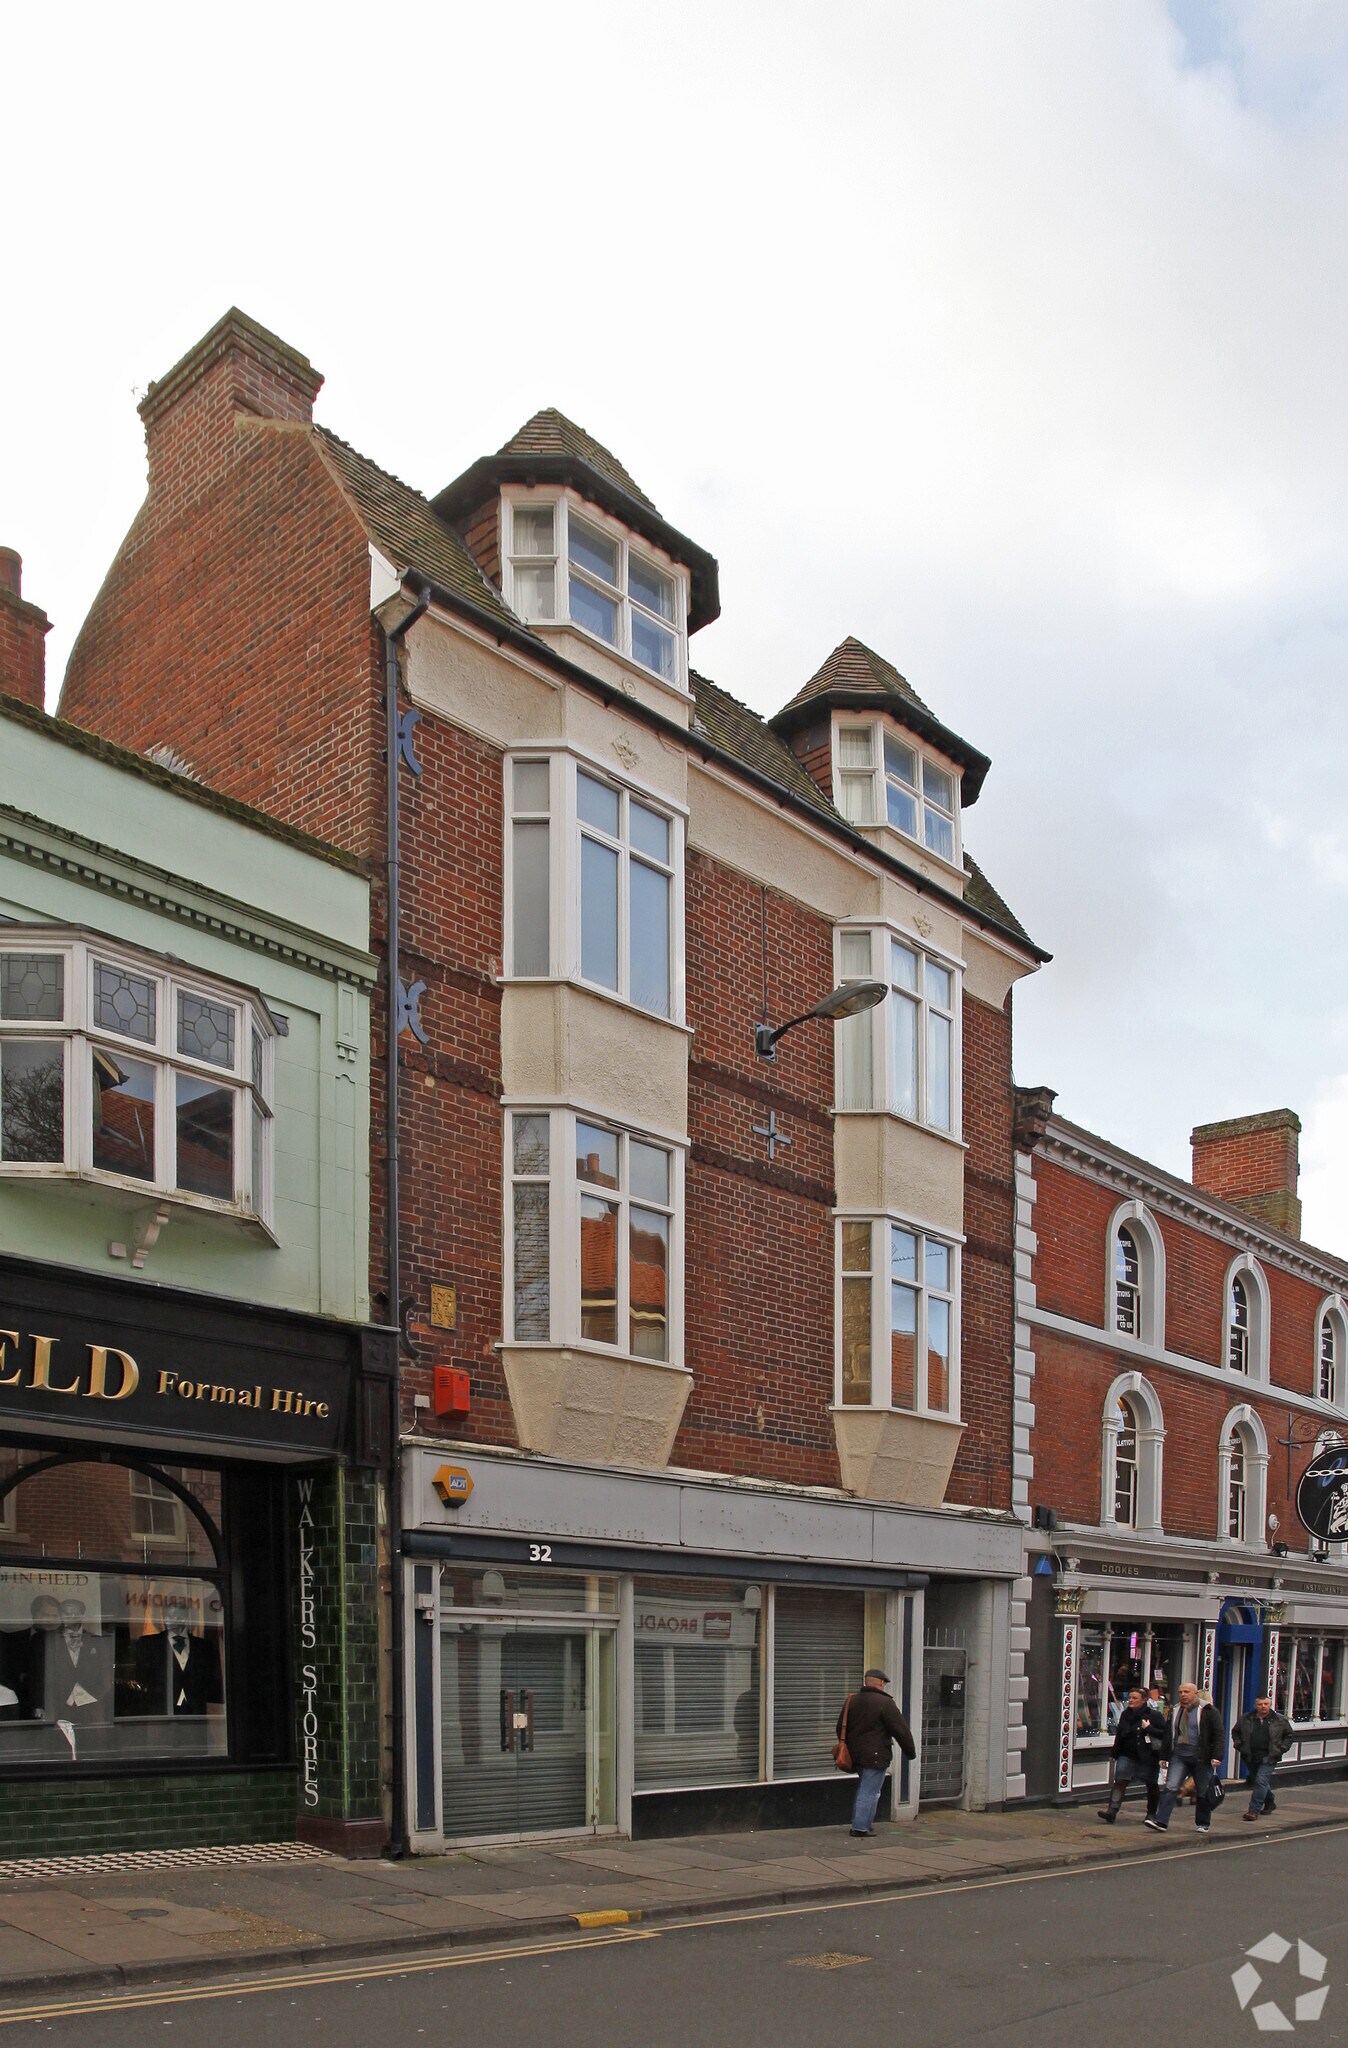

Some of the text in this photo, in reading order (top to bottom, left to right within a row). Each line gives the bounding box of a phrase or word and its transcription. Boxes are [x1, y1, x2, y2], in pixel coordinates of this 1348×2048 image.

[156, 1369, 262, 1409] Formal
[270, 1388, 330, 1419] Hire
[450, 1477, 467, 1489] ADT
[529, 1544, 552, 1562] 32
[1101, 1564, 1139, 1576] COOKES
[38, 1572, 89, 1588] FIELD
[296, 1478, 319, 1807] WALKERS STORES
